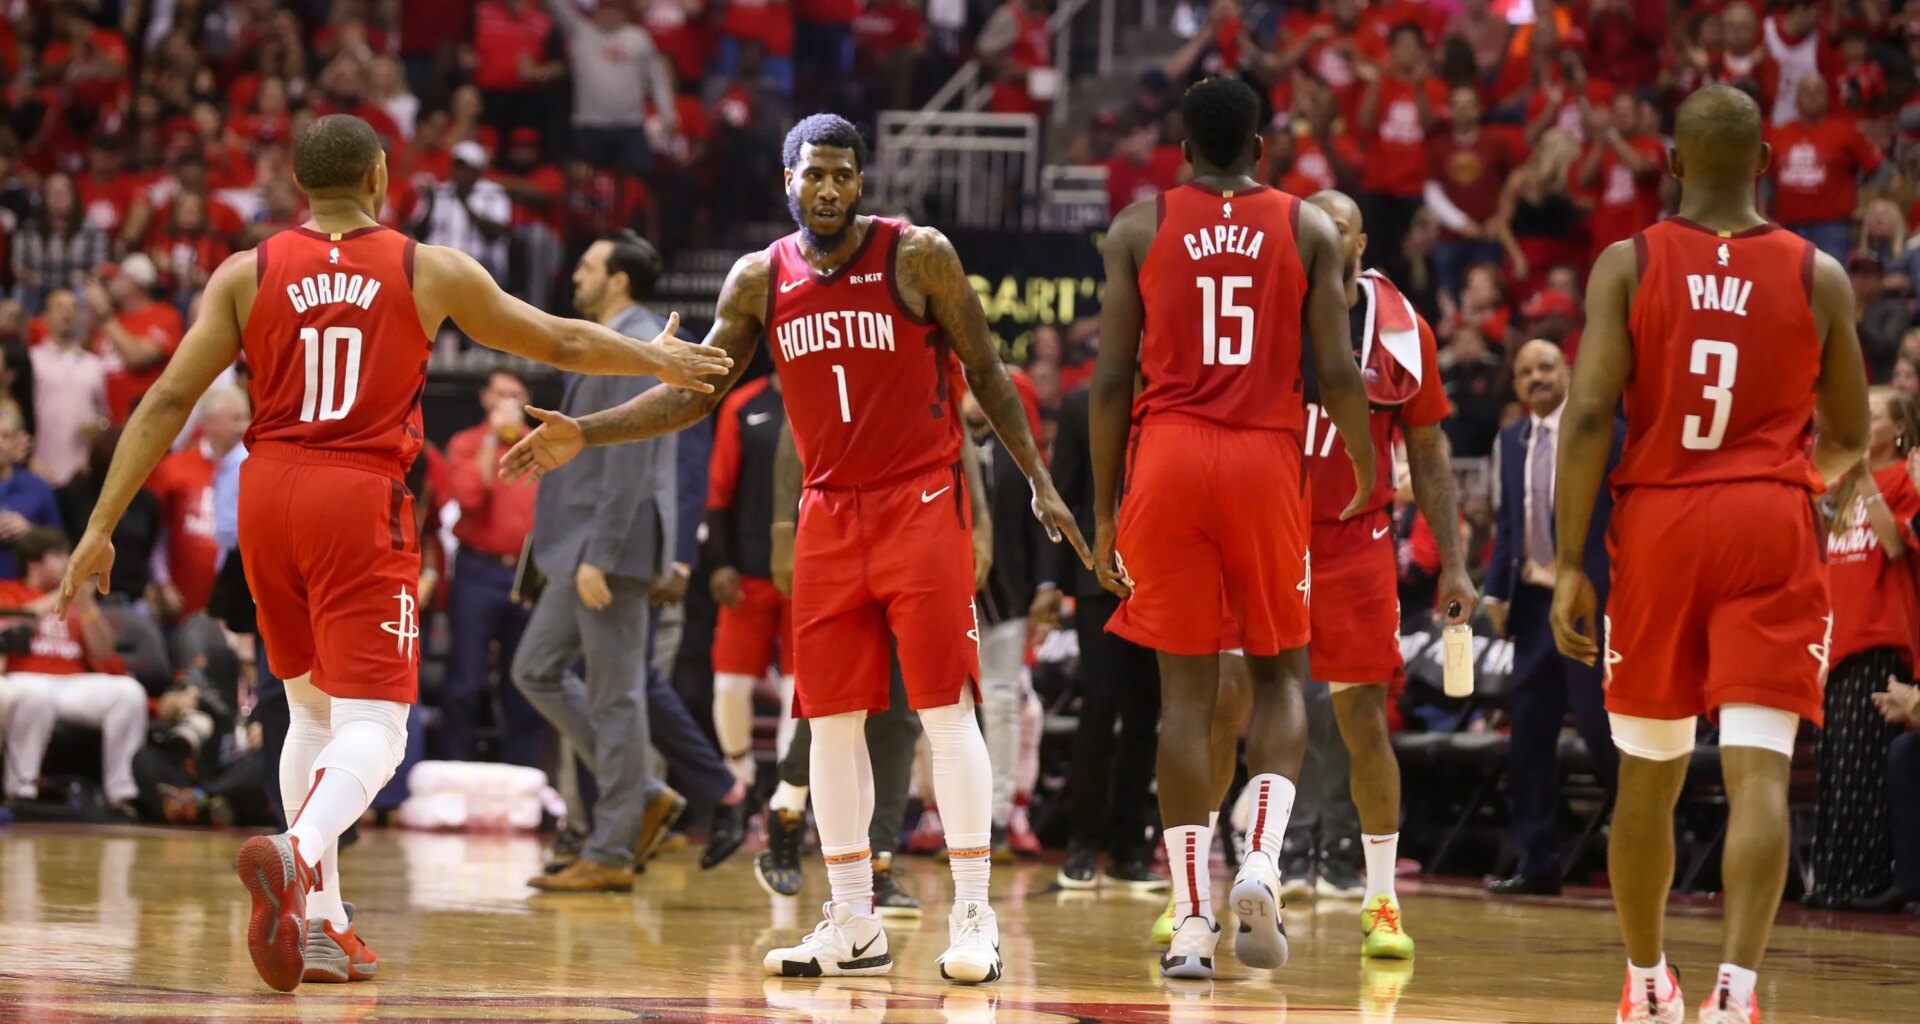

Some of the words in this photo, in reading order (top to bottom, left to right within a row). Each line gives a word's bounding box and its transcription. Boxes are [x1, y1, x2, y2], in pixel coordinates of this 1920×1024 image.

[1183, 225, 1265, 260] CAPELA
[286, 272, 382, 313] GORDON
[1196, 276, 1254, 365] 15
[1686, 274, 1753, 316] PAUL
[776, 310, 895, 362] HOUSTON
[299, 326, 363, 422] 10
[832, 364, 851, 423] 1
[1681, 338, 1738, 450] 3
[1304, 402, 1337, 458] 17
